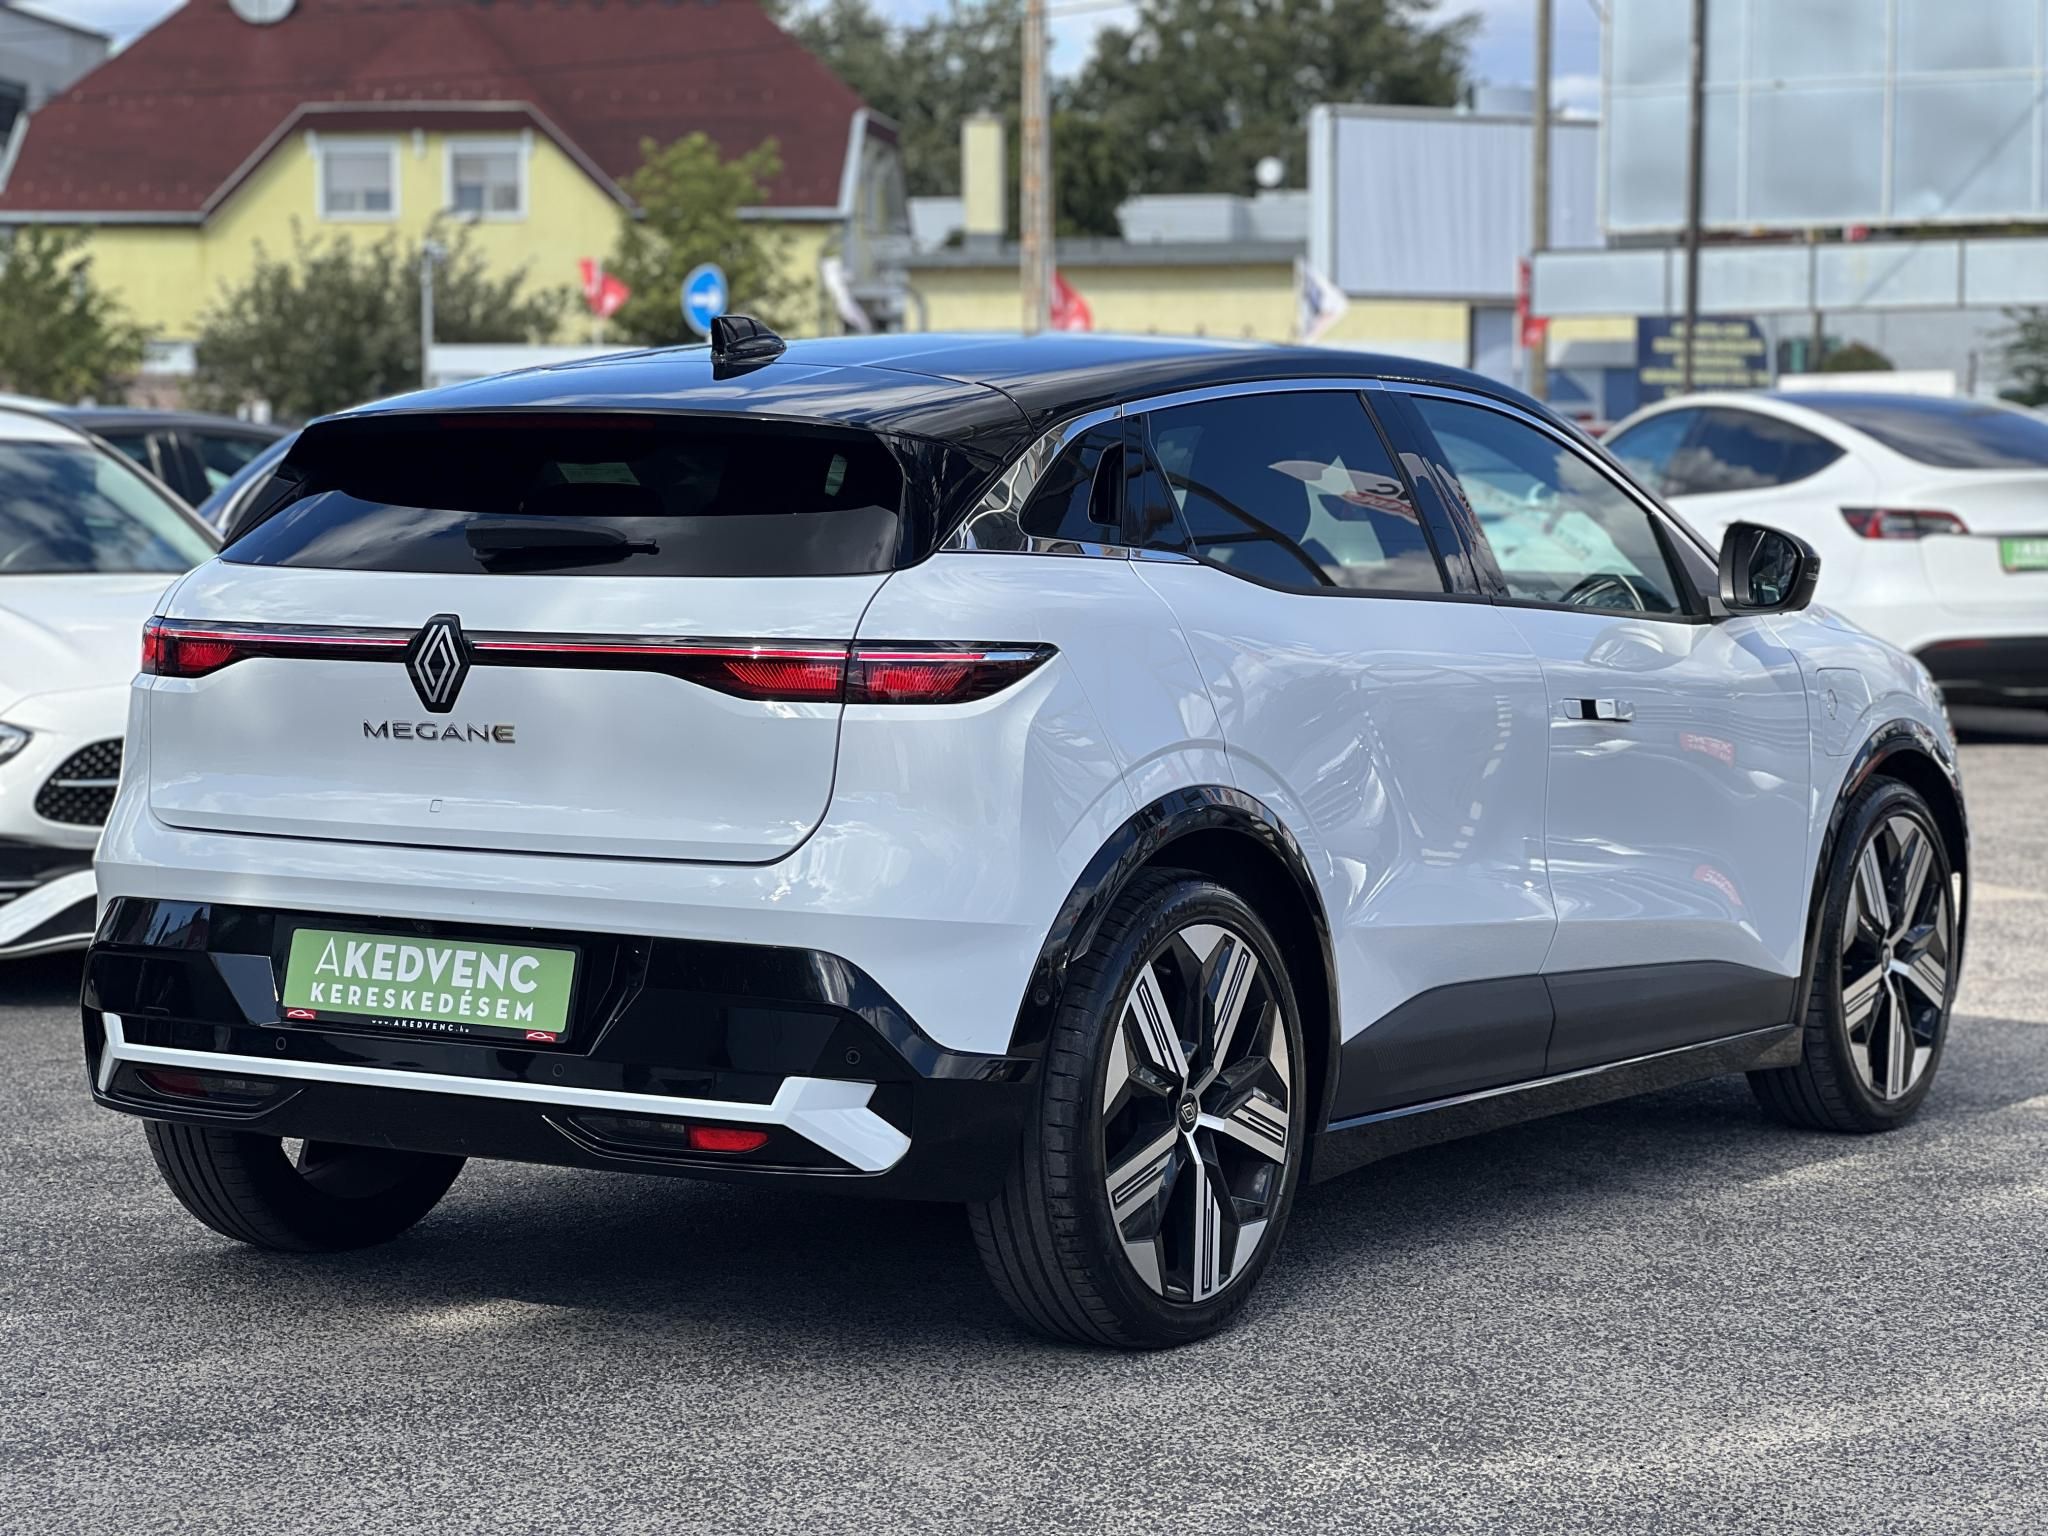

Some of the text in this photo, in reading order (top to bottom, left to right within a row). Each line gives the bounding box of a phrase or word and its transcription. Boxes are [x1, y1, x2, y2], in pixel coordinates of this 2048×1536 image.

[363, 719, 516, 744] MEGANE
[314, 936, 540, 994] AKEDVENC
[310, 981, 535, 1022] KERESKEDÉSEM
